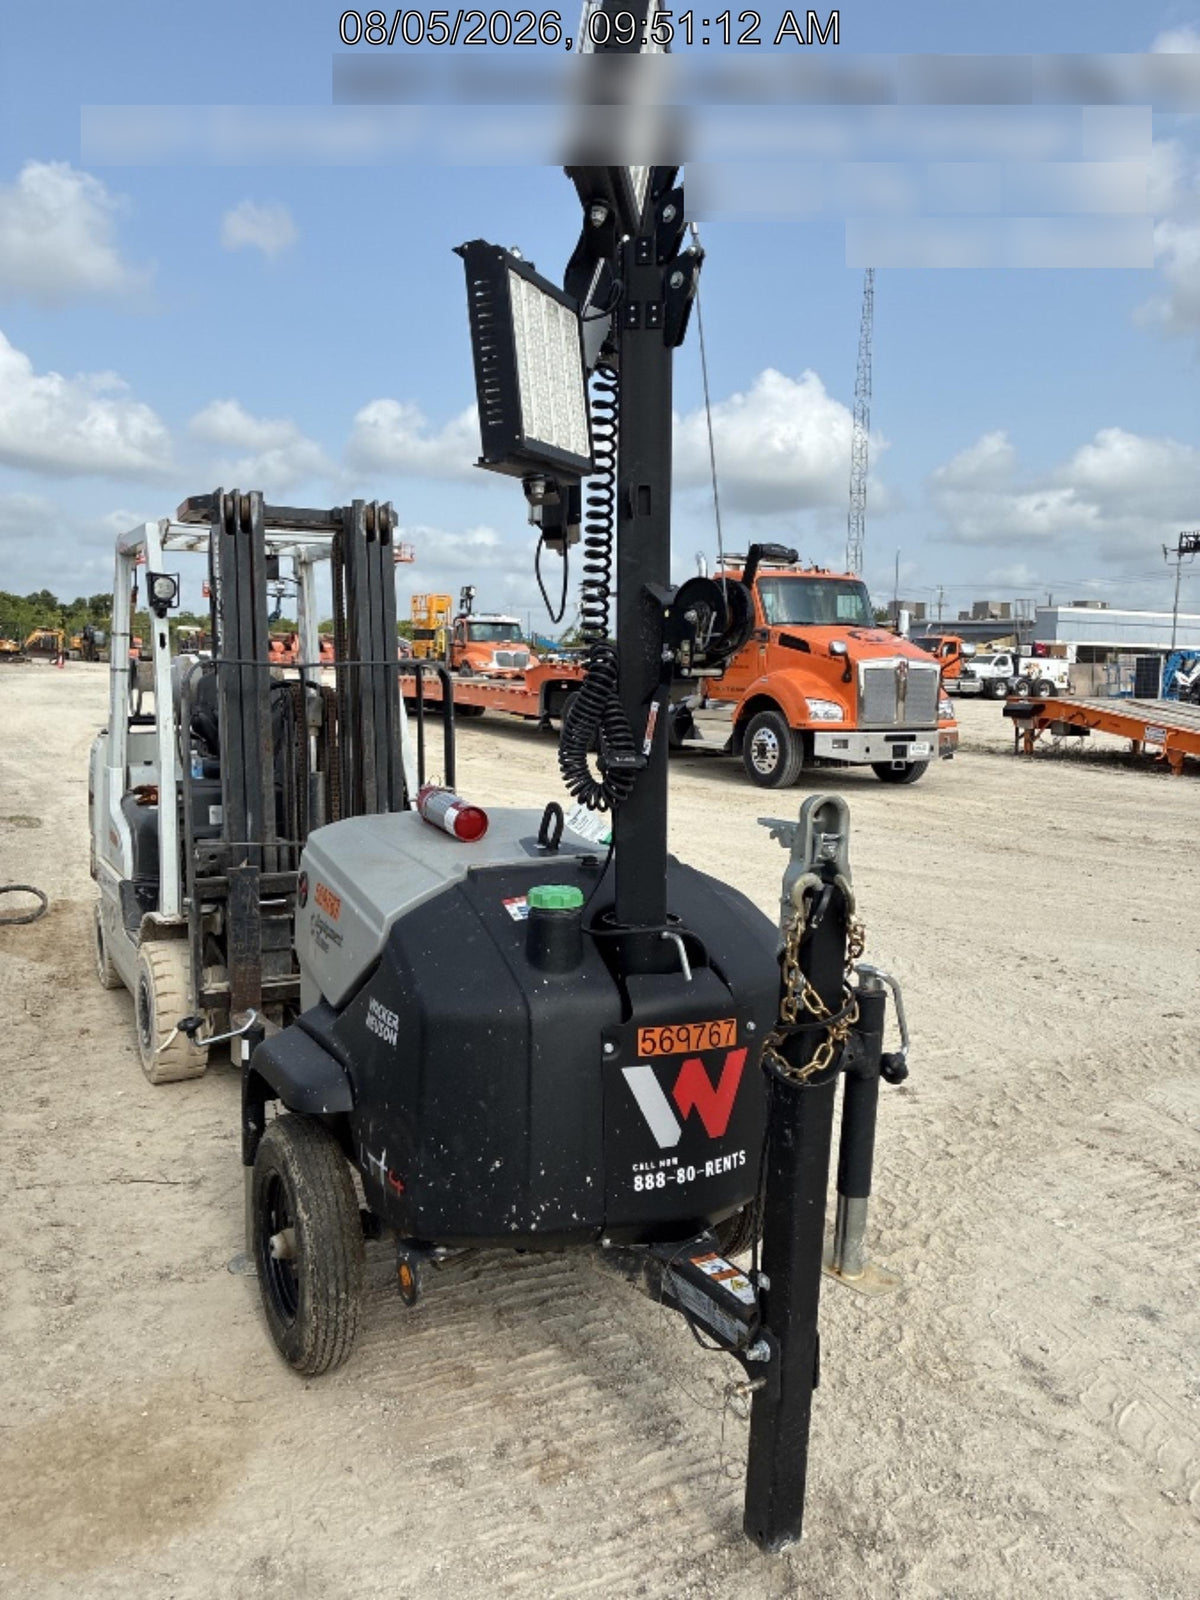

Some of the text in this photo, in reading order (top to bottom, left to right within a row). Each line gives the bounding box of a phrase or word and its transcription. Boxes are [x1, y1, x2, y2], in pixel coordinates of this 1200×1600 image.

[640, 1019, 736, 1055] 569767
[632, 1156, 679, 1173] CALL NOW
[633, 1149, 746, 1192] 888-80-RENTS
